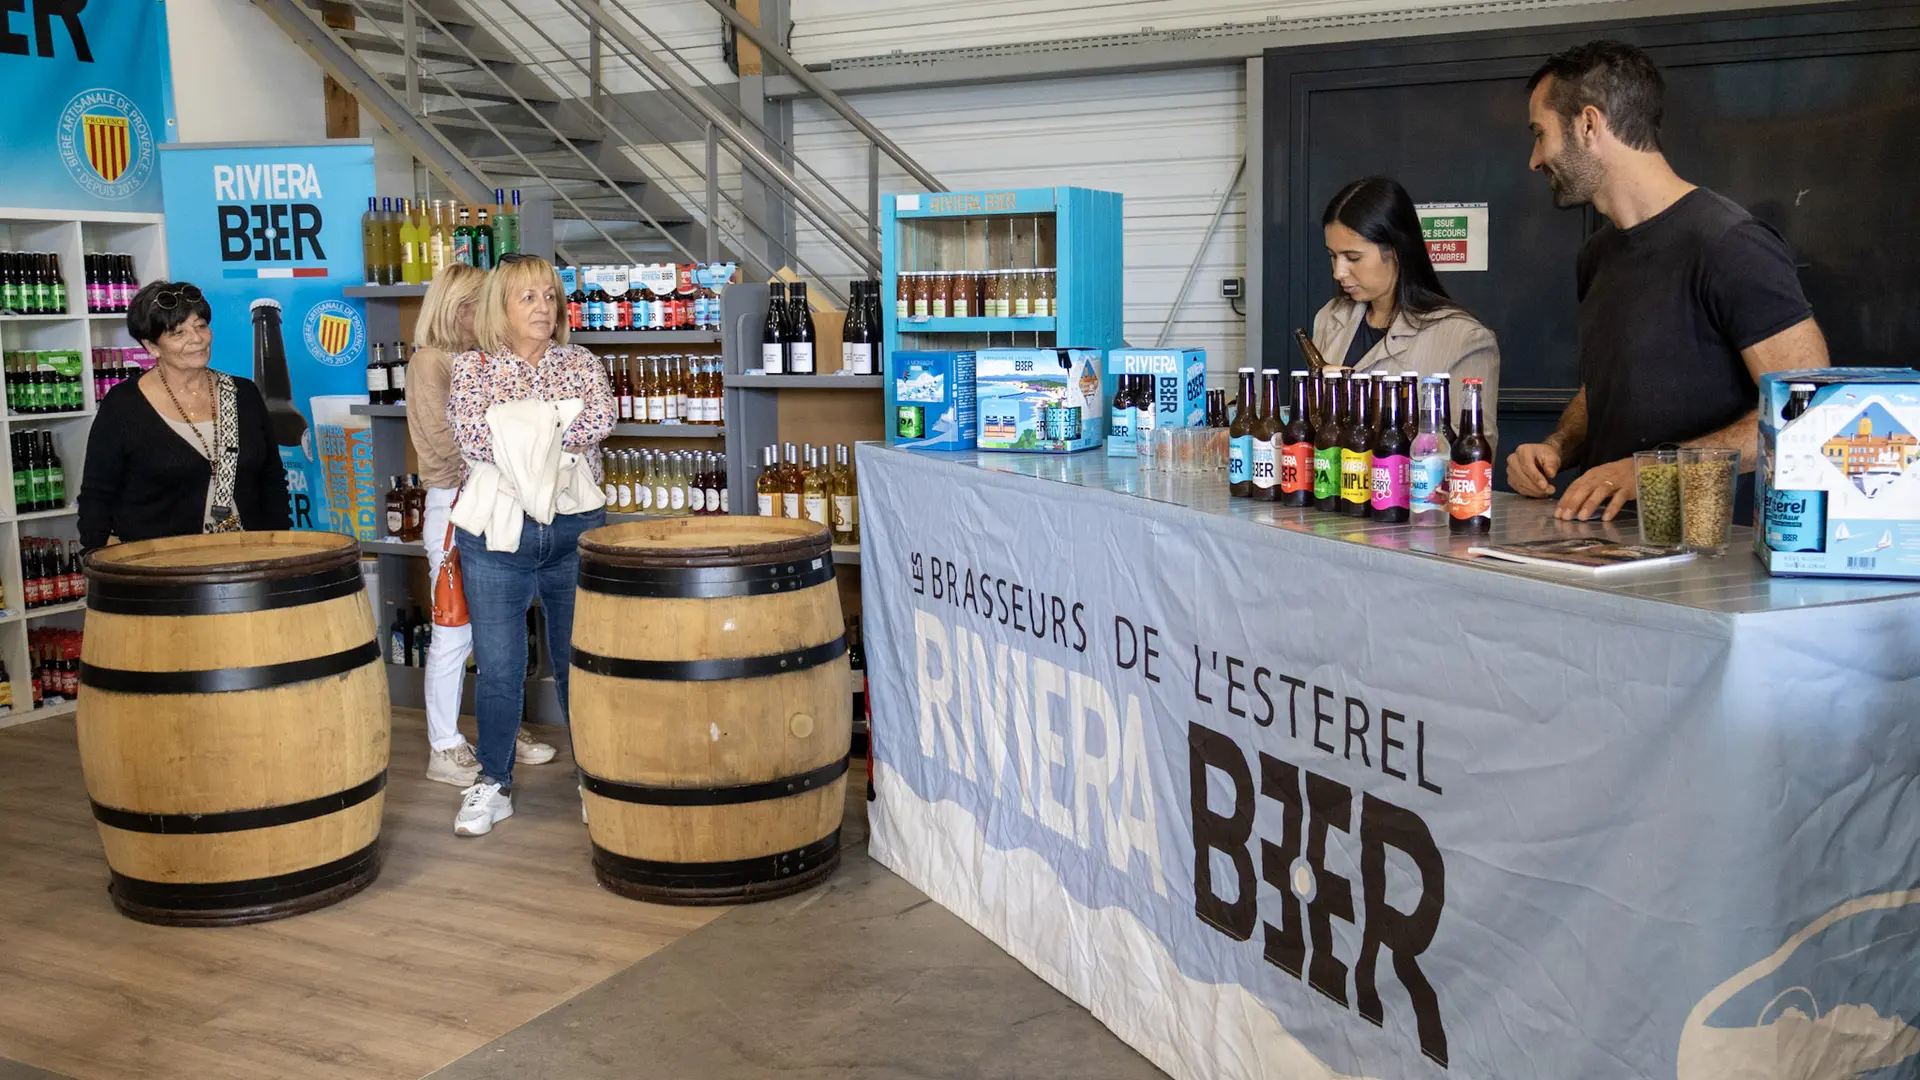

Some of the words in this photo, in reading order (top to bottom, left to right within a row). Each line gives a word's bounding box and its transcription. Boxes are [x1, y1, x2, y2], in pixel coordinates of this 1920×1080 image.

[63, 93, 115, 131] ARTISANALE
[117, 98, 131, 114] DE
[129, 110, 151, 172] PROVENCE
[80, 173, 115, 196] DEPUIS
[118, 177, 140, 196] 2015
[213, 163, 323, 201] RIVIERA
[931, 195, 981, 213] RIVIERA
[217, 203, 327, 262] BEER
[1423, 229, 1432, 238] DE
[1433, 228, 1467, 238] SECOURS
[1434, 219, 1455, 228] ISSUE
[1430, 253, 1466, 262] COMBRER
[1431, 243, 1441, 252] NE
[1442, 243, 1456, 252] PAS
[1125, 355, 1178, 374] RIVIERA
[1160, 377, 1178, 413] BEER
[351, 429, 377, 517] RIVIERA
[911, 551, 925, 595] LES
[931, 556, 1087, 653] BRASSEURS
[1115, 615, 1161, 683] DE
[1194, 644, 1443, 796] L'ESTEREL
[914, 607, 1167, 897] RIVIERA
[1188, 720, 1449, 1069] BEER
